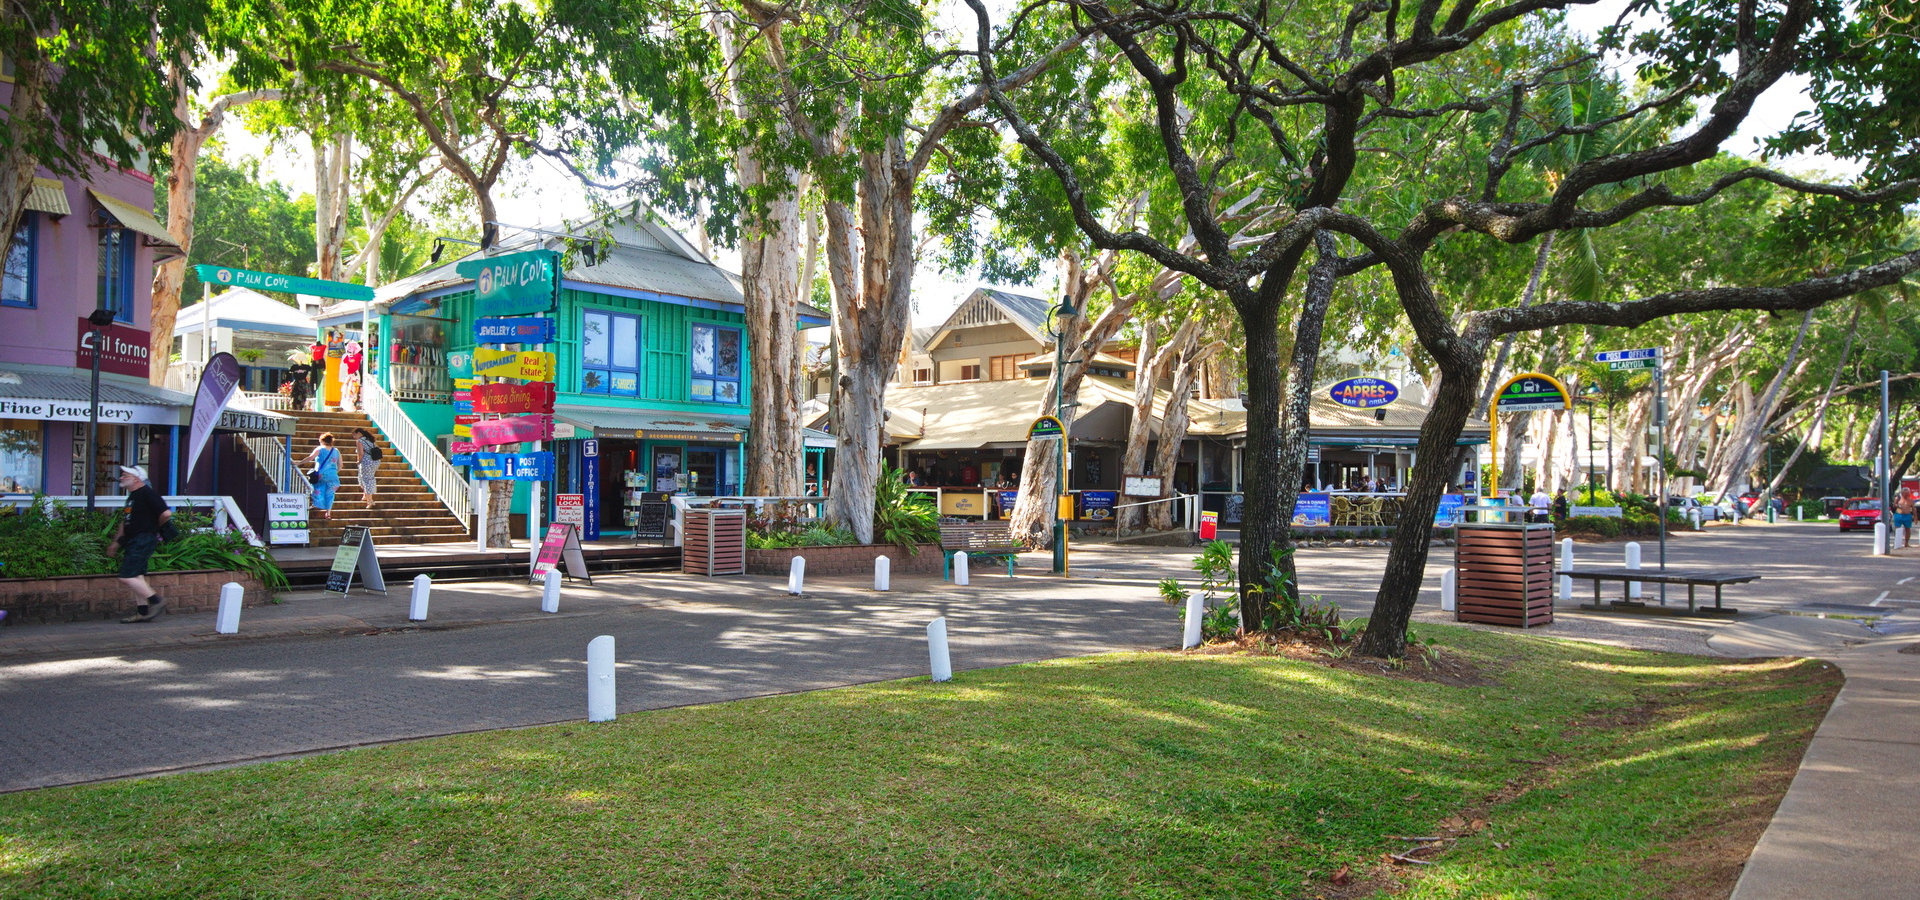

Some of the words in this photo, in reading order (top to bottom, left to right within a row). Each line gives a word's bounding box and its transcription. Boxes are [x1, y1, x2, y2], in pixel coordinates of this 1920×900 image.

[236, 271, 262, 285] PALM
[264, 275, 289, 289] COVE
[493, 264, 518, 290] PALM
[520, 259, 548, 287] COVE
[479, 325, 511, 336] JEWELLERY
[102, 335, 110, 352] il
[114, 337, 148, 359] forno
[523, 356, 540, 366] Real
[1628, 350, 1650, 359] OFFICE
[475, 353, 517, 372] SUPERMARKET
[520, 367, 542, 377] Estate
[1343, 385, 1385, 398] APRES
[481, 389, 508, 411] alfresco
[0, 401, 42, 415] Fine
[519, 457, 536, 466] POST
[516, 468, 539, 477] OFFICE
